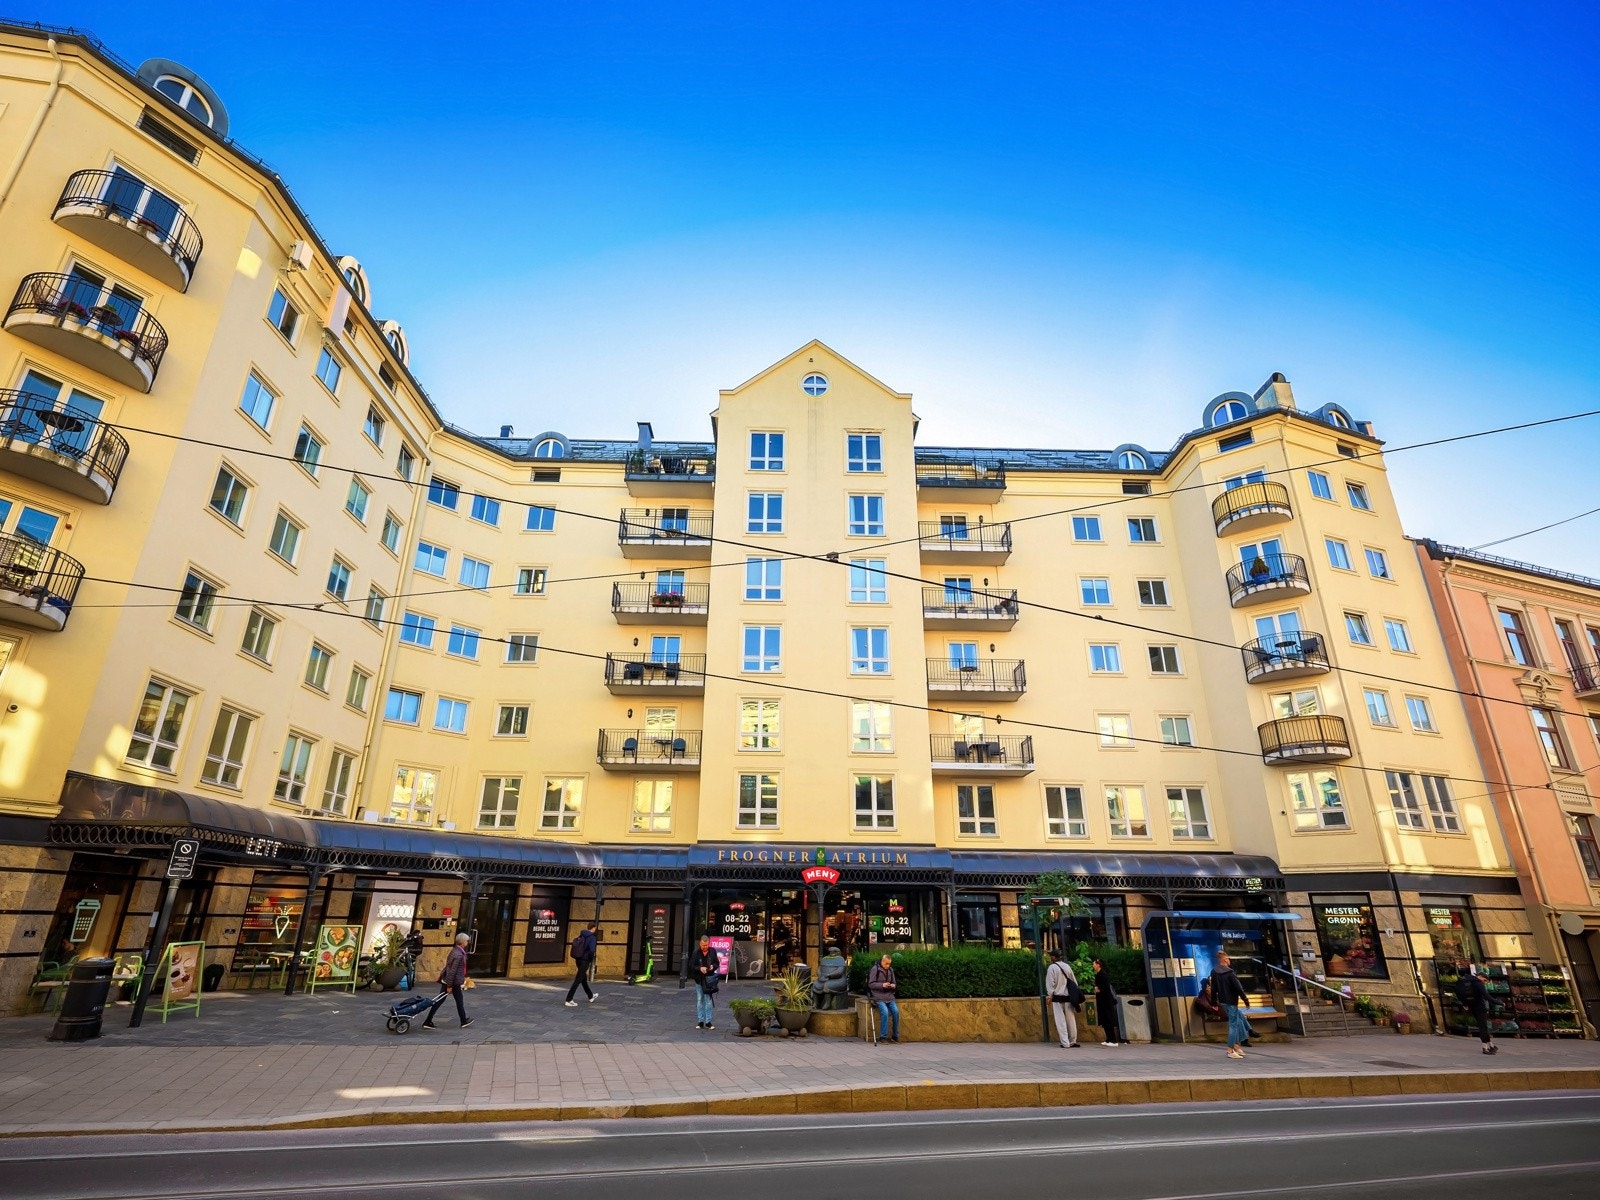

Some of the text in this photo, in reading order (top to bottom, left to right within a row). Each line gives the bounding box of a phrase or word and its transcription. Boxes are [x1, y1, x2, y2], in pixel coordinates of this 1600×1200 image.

[246, 837, 281, 858] LETT
[718, 850, 907, 864] FROGNER ATRIUM
[806, 869, 836, 880] MENY
[431, 902, 437, 911] 8
[1325, 907, 1360, 915] MESTER
[725, 914, 749, 922] 08-22
[884, 916, 909, 925] 08-22
[1432, 917, 1452, 925] GRØNN
[722, 925, 751, 933] (08-20)
[883, 926, 912, 936] (08-20)
